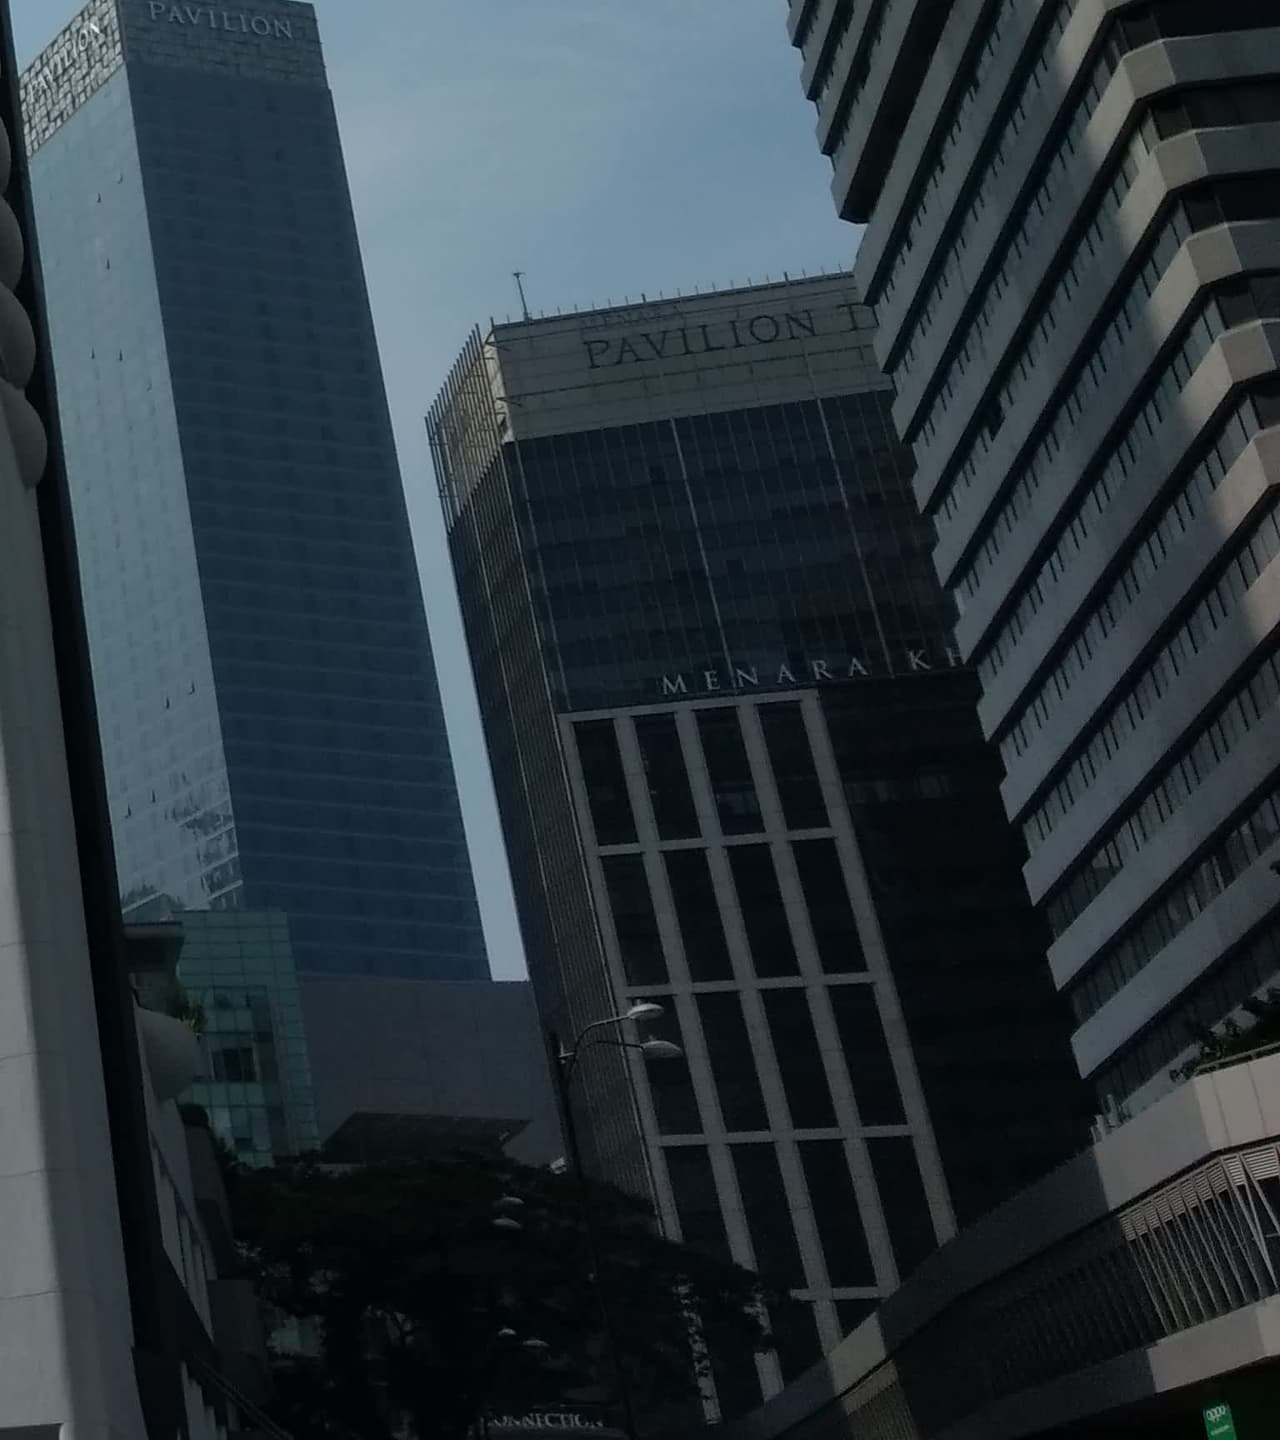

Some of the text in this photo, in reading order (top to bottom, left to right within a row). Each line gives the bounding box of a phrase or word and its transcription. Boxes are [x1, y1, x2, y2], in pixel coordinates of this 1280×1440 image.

[148, 1, 293, 39] PAVILION
[582, 308, 818, 368] PAVILION
[660, 657, 872, 695] MENARA
